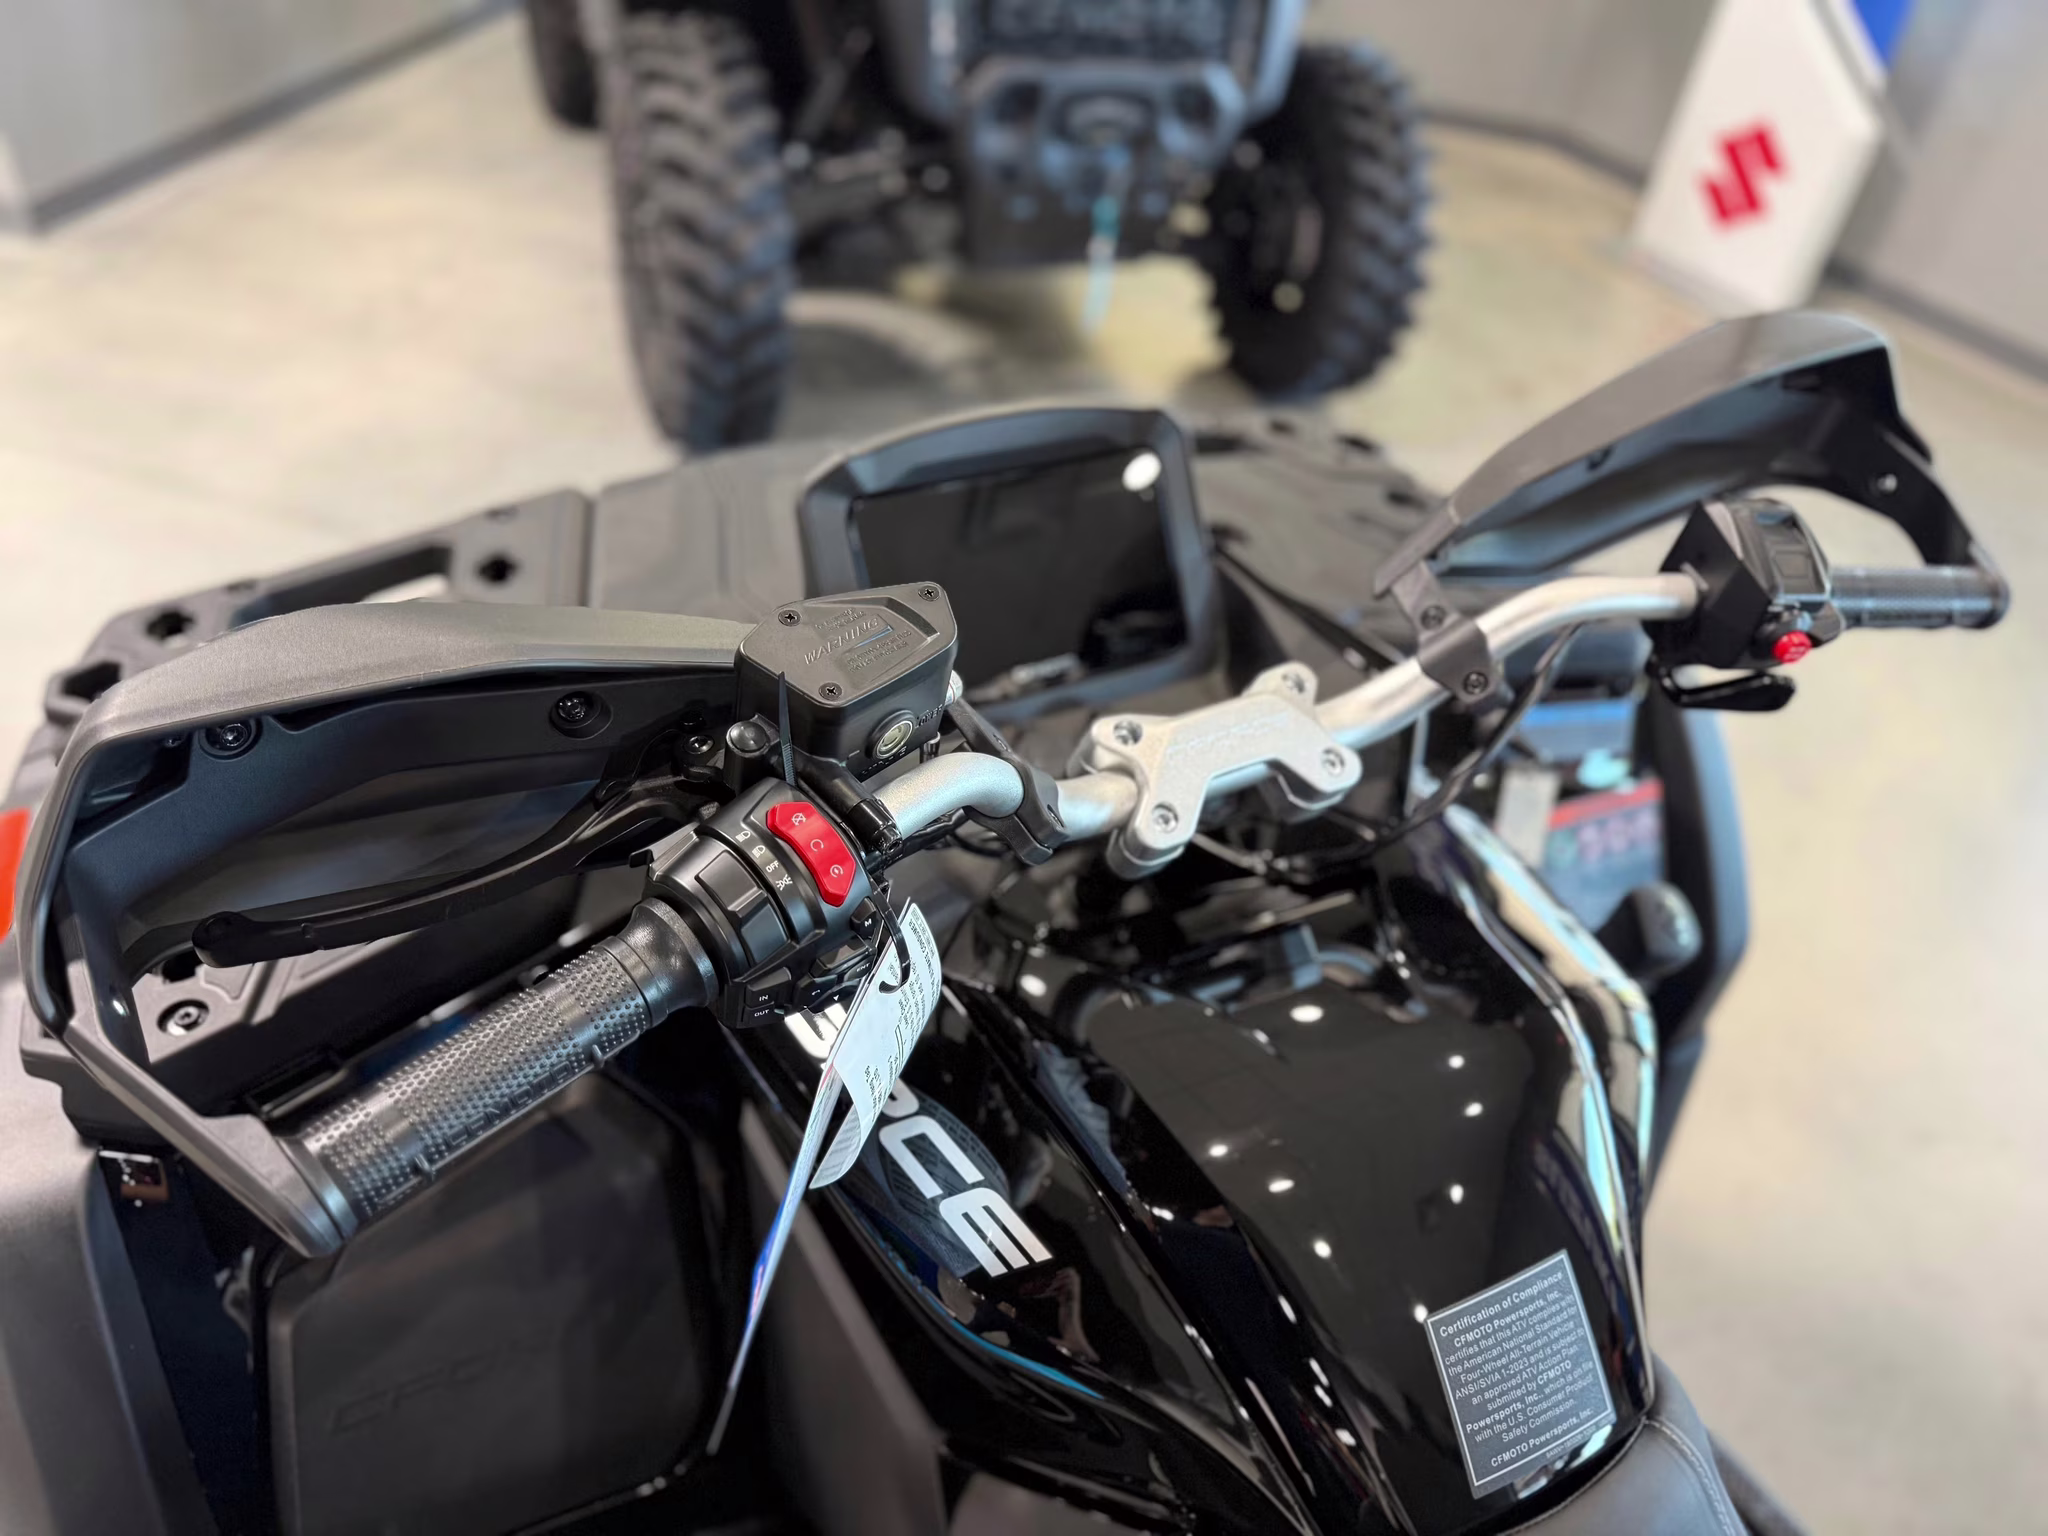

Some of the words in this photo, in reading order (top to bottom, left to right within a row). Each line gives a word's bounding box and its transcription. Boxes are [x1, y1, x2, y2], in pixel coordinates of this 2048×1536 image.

[804, 618, 879, 665] WARNING
[765, 860, 780, 874] OFF
[863, 918, 872, 927] M
[908, 918, 926, 952] CONSUMER
[754, 1008, 770, 1018] OUT
[759, 993, 769, 1003] IN
[1439, 1303, 1501, 1337] Certification
[1512, 1271, 1562, 1303] Compliance
[1444, 1344, 1478, 1364] certifies
[1478, 1334, 1496, 1349] that
[1495, 1328, 1511, 1341] this
[1511, 1318, 1526, 1333] ATV
[1527, 1303, 1560, 1325] complies
[1559, 1294, 1574, 1306] with
[1453, 1323, 1492, 1347] CFMOTO
[1492, 1298, 1547, 1329] Powersports,
[1546, 1290, 1561, 1301] Inc.
[1448, 1364, 1462, 1376] the
[1463, 1346, 1502, 1369] American
[1501, 1327, 1534, 1350] National
[1534, 1310, 1568, 1333] Standard
[1567, 1305, 1576, 1314] for
[1455, 1371, 1501, 1399] ANSI/SVIA
[1501, 1356, 1528, 1377] 1-2023
[1529, 1348, 1544, 1363] and
[1551, 1330, 1577, 1351] subject
[1460, 1354, 1509, 1383] Four-Wheel
[1509, 1335, 1548, 1360] All-Terrain
[1547, 1320, 1574, 1339] Vehicle
[1465, 1401, 1524, 1433] Powersports,
[1543, 1377, 1565, 1394] which
[1581, 1361, 1592, 1371] file
[1483, 1373, 1521, 1399] approved
[1522, 1364, 1536, 1380] ATV
[1538, 1353, 1561, 1371] Action
[1561, 1344, 1578, 1358] Plan
[1486, 1384, 1526, 1410] submitted
[1537, 1359, 1571, 1384] CFMOTO
[1474, 1428, 1493, 1442] with
[1493, 1422, 1507, 1433] the
[1507, 1411, 1526, 1426] U.S.
[1526, 1390, 1565, 1416] Consumer
[1565, 1373, 1593, 1395] Product
[1501, 1424, 1527, 1442] Safety
[1528, 1398, 1576, 1428] Commission.
[1490, 1442, 1528, 1466] CFMOTO
[1528, 1416, 1579, 1448] Powersports,
[1578, 1407, 1593, 1419] Inc.
